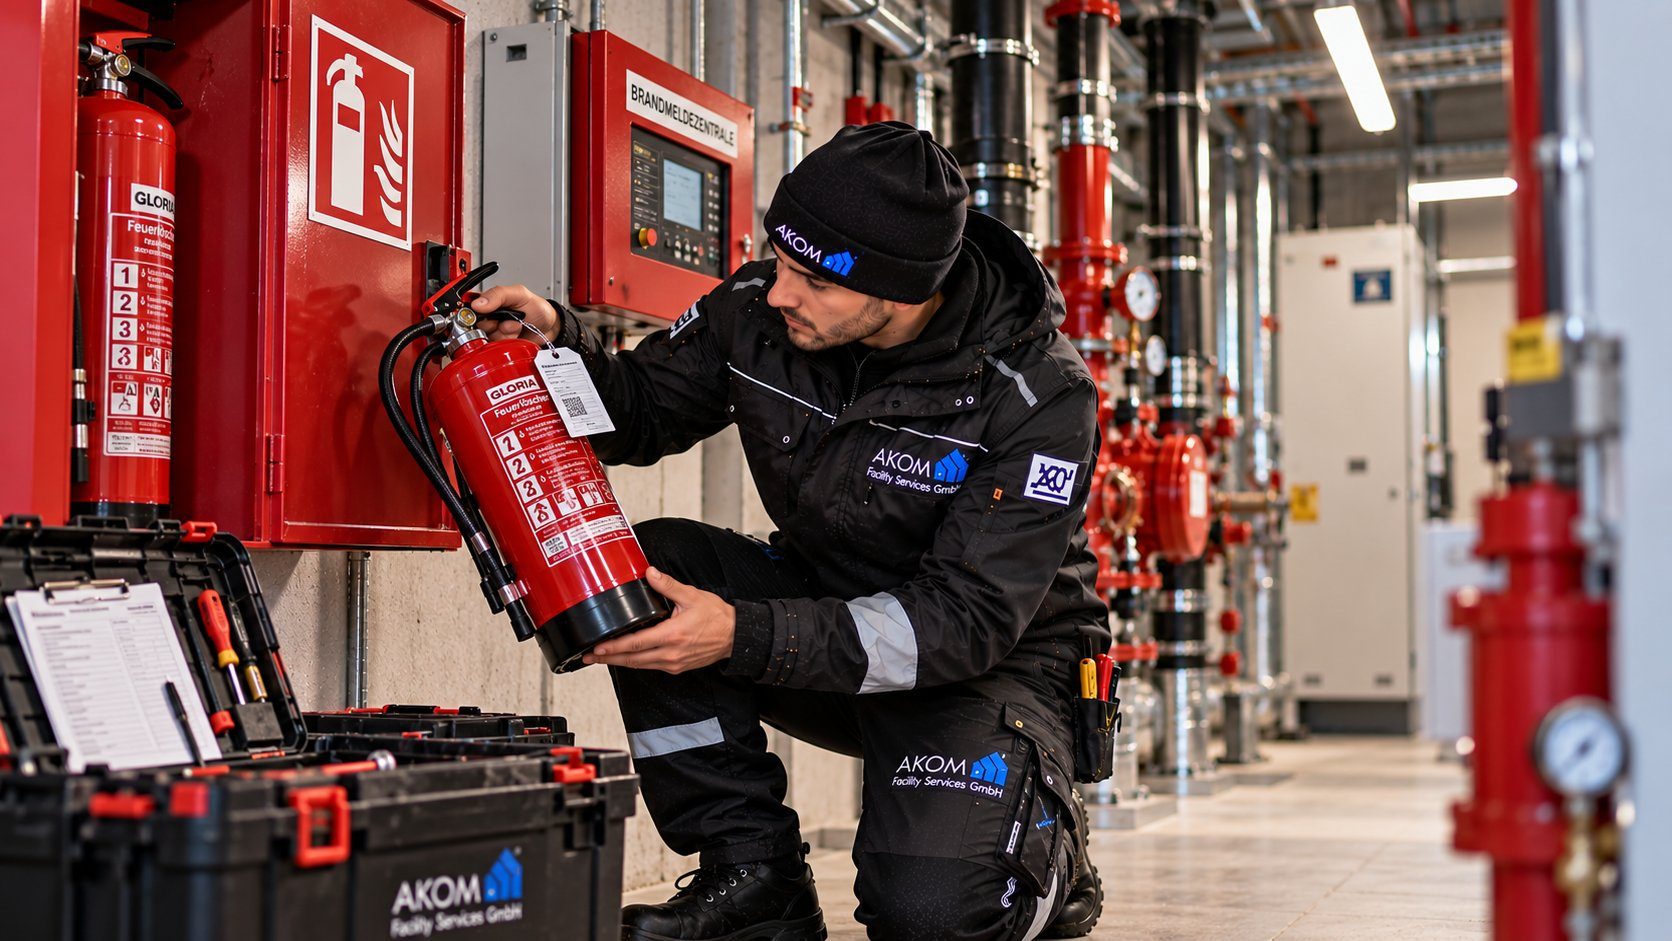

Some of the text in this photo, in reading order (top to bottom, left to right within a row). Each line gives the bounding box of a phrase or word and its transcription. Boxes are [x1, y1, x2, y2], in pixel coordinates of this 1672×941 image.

[631, 83, 734, 147] BRANDMELDEZENTRALE
[134, 191, 174, 214] GLORIA
[775, 224, 822, 263] AKOM
[121, 266, 129, 285] 1
[120, 293, 132, 311] 2
[119, 320, 131, 338] 3
[490, 378, 537, 400] GLORIA
[872, 448, 930, 478] AKOM
[895, 475, 931, 492] Services
[896, 755, 966, 776] AKOM
[924, 776, 966, 790] Services
[970, 781, 1004, 798] GmbH
[391, 873, 481, 915] AKOM
[435, 910, 485, 931] Services
[486, 902, 523, 924] GmbH
